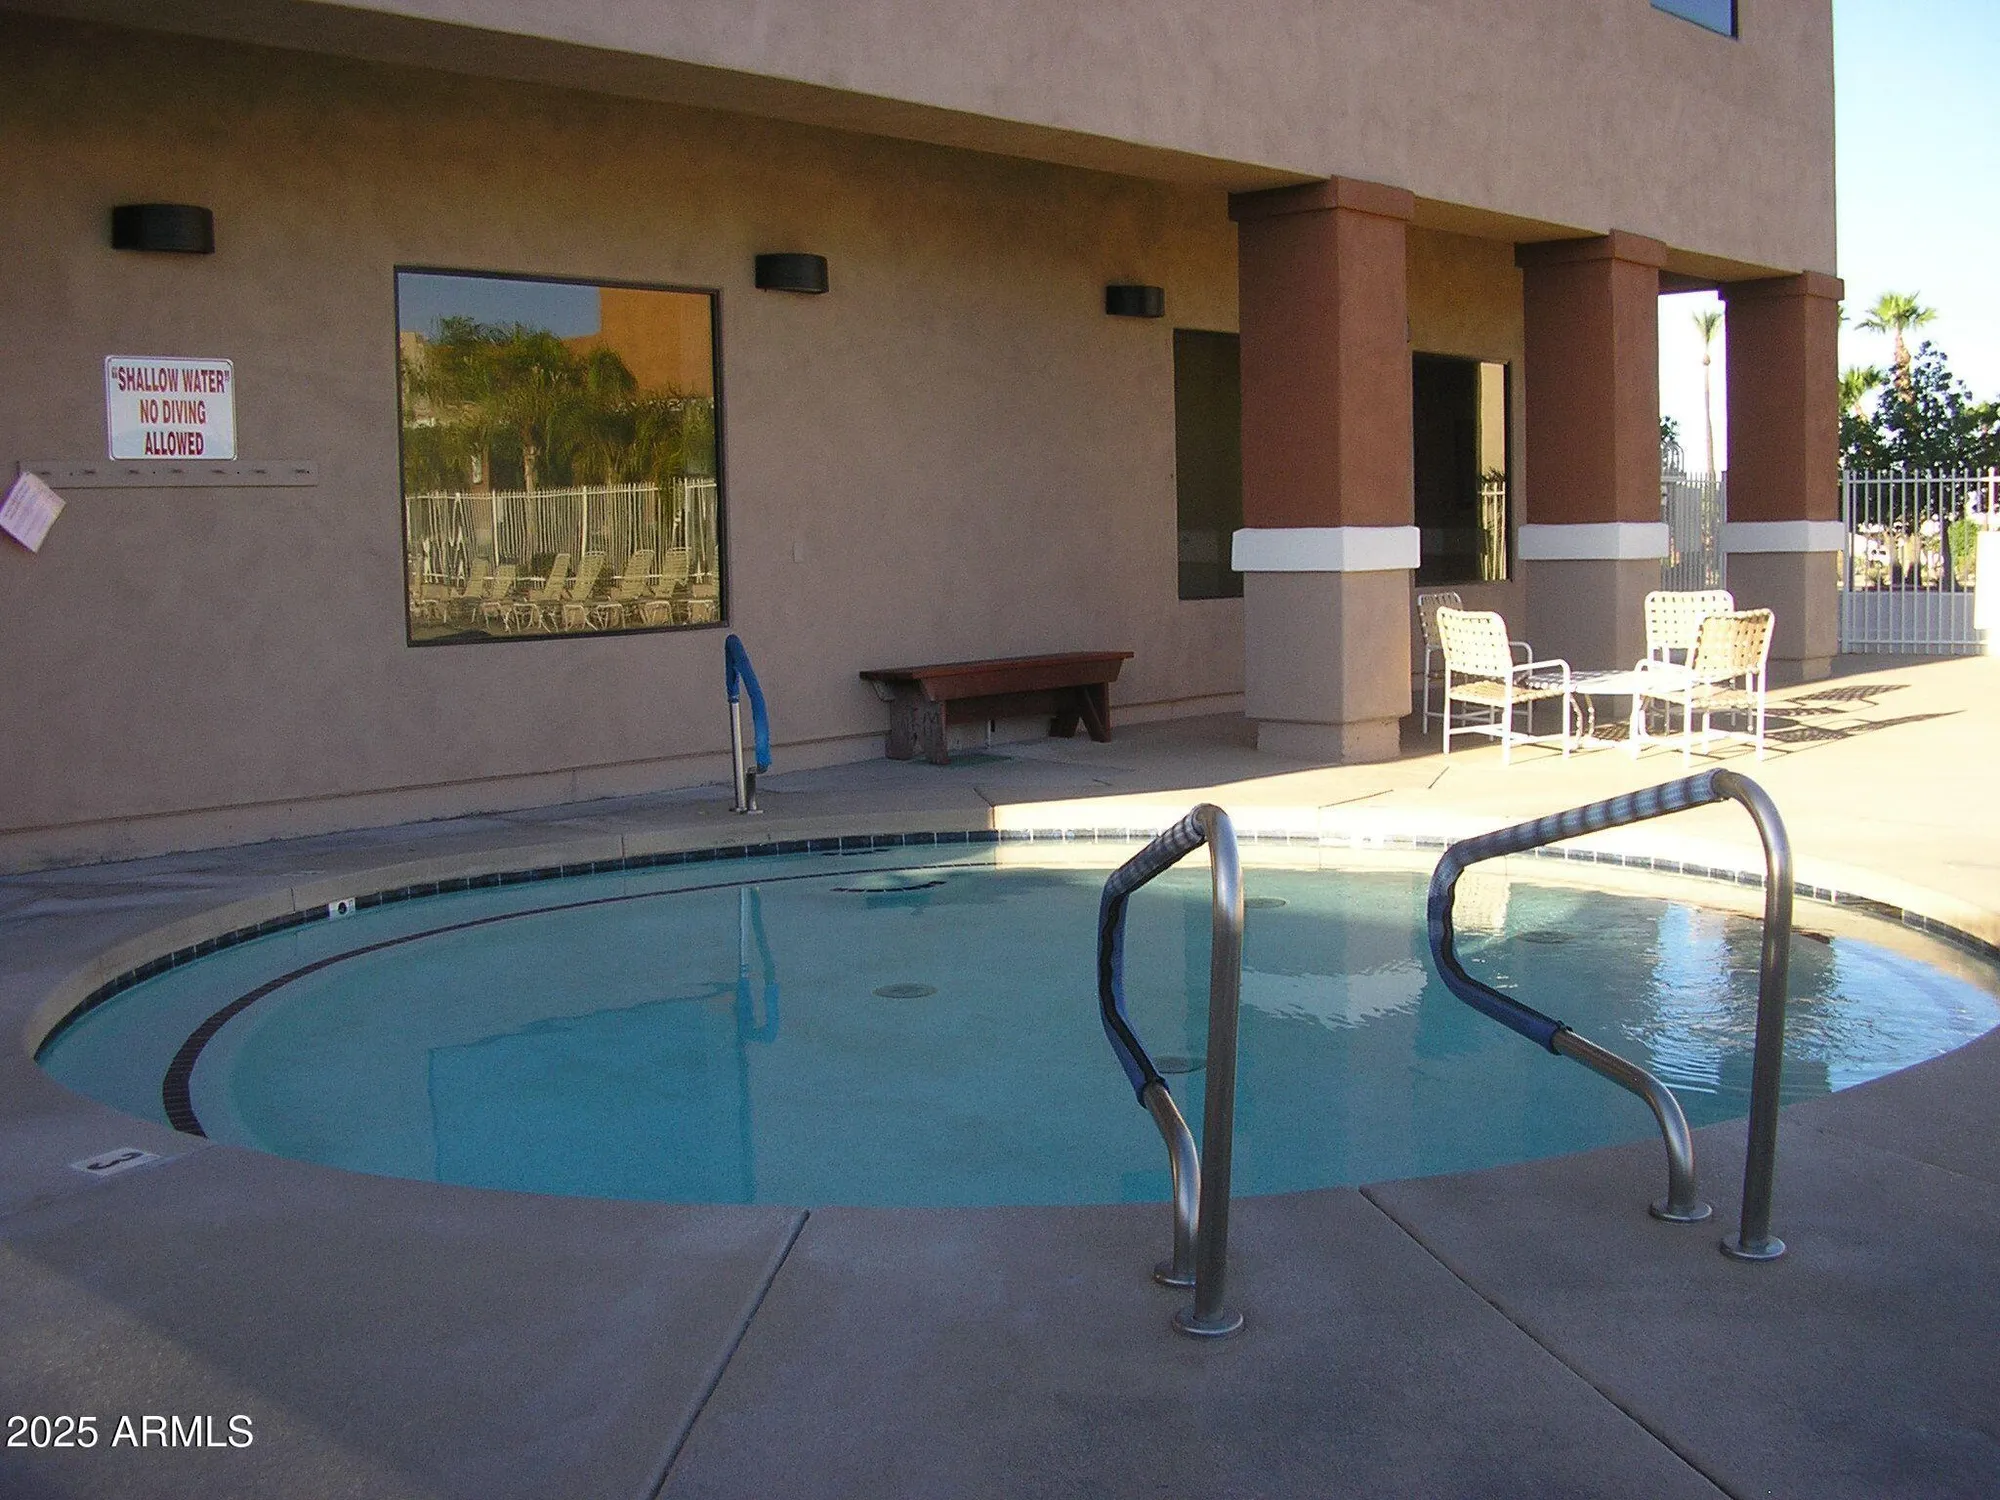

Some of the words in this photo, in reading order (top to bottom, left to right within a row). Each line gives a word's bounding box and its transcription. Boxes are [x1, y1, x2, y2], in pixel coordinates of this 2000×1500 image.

[140, 399, 159, 423] NO
[162, 400, 206, 424] DIVING
[145, 431, 204, 456] ALLOWED
